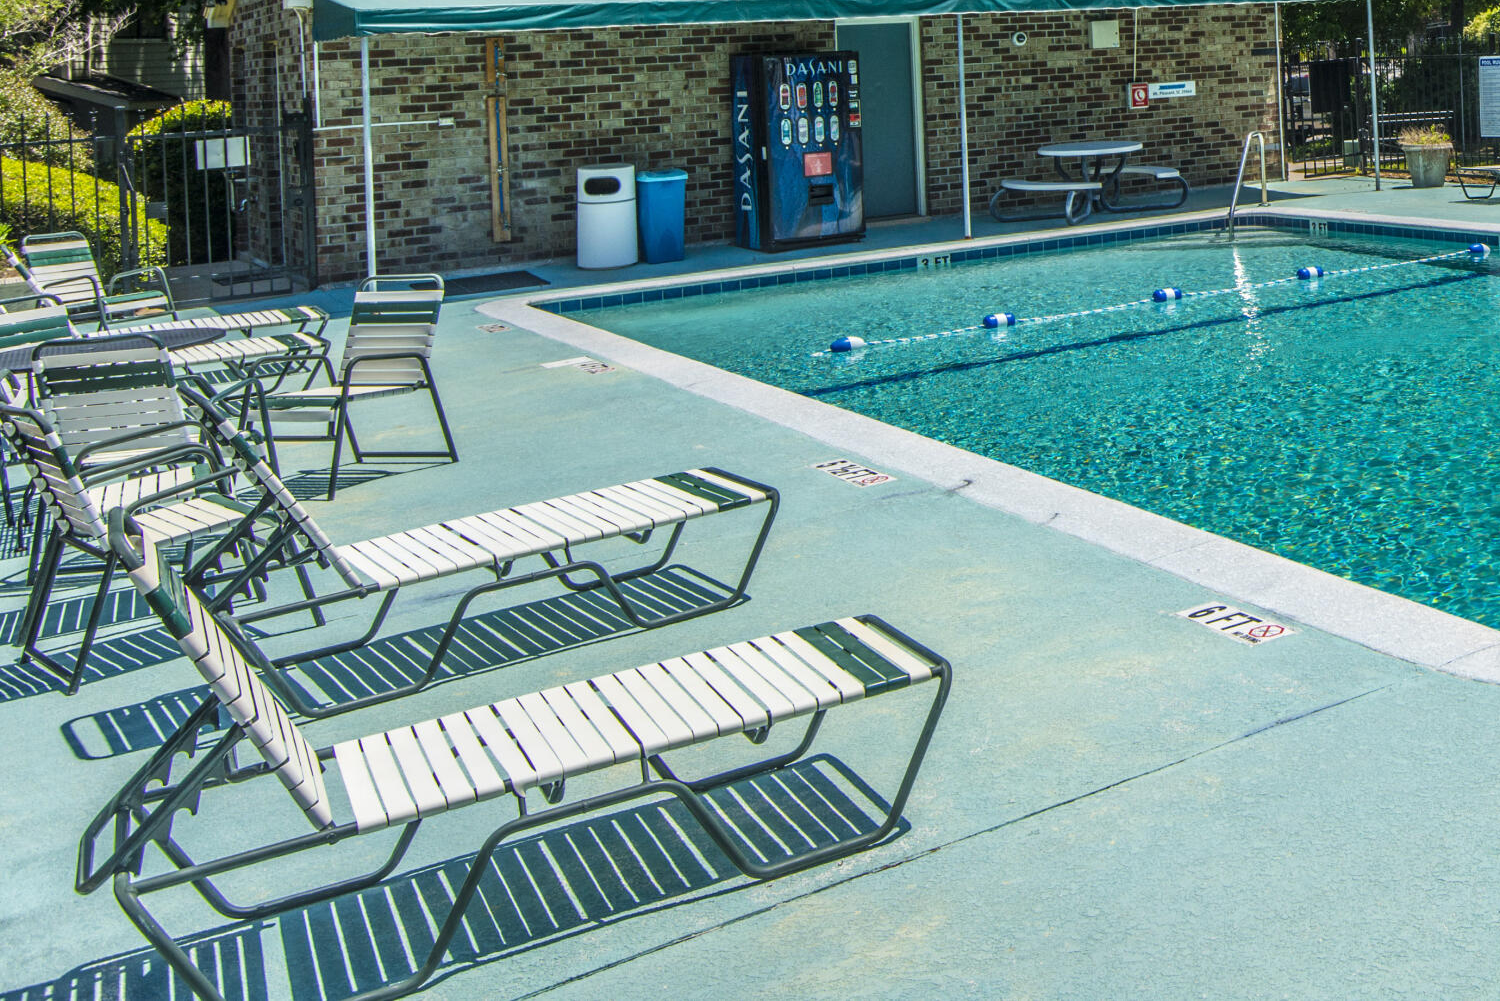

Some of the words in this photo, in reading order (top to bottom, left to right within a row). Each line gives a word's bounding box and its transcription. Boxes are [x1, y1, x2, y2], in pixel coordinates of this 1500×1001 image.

[786, 59, 843, 77] DASANI
[737, 90, 754, 211] DASANI
[1188, 605, 1227, 618] 6
[1205, 612, 1263, 630] FT
